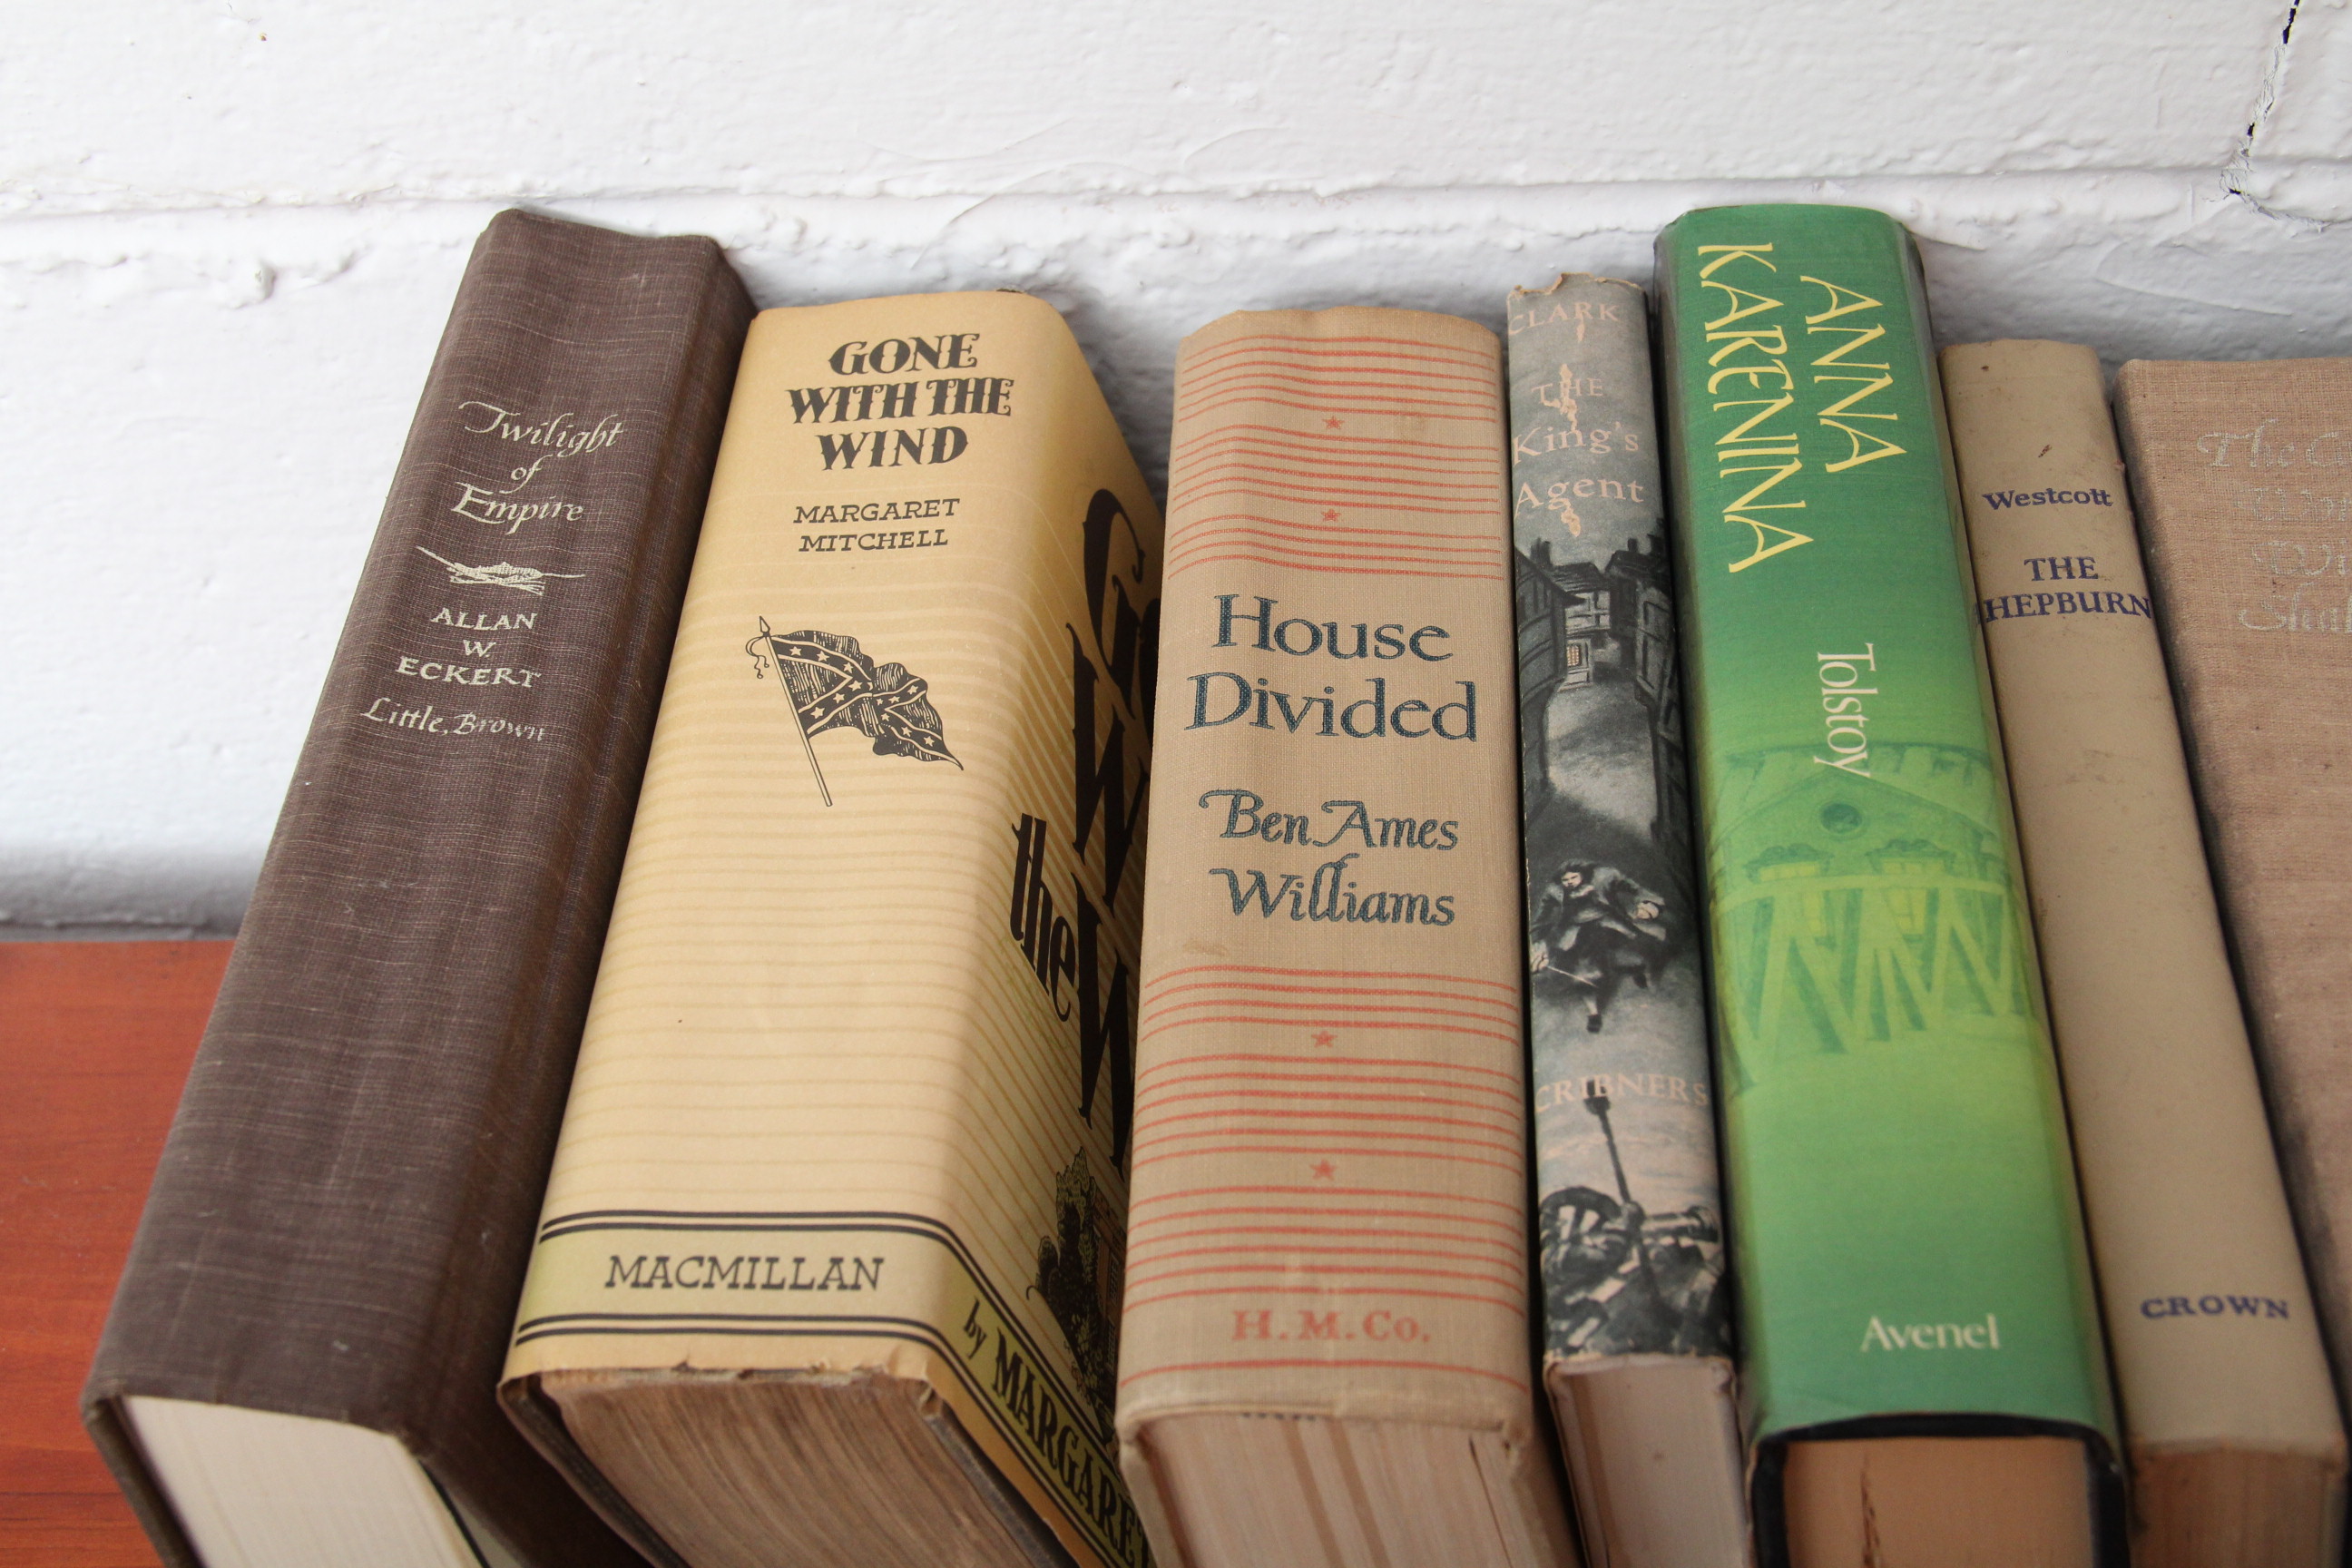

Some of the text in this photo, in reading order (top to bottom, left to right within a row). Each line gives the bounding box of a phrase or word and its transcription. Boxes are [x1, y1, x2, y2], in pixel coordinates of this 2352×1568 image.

[1508, 300, 1619, 336] CLARK
[828, 333, 981, 376] GONE
[1799, 275, 1907, 473] ANNA
[785, 377, 1015, 425] WITH THE
[1531, 377, 1605, 407] THE
[1697, 242, 1814, 573] KARENINA
[458, 400, 624, 459] Twilight
[814, 425, 969, 471] WIND
[1512, 421, 1640, 466] King's
[2196, 417, 2296, 468] The
[499, 454, 553, 495] of
[450, 481, 584, 535] Empire
[793, 497, 961, 524] MARGARET
[1514, 477, 1645, 522] Agent
[1982, 486, 2114, 511] Westcott
[799, 529, 949, 553] MITCHELL
[2023, 555, 2100, 582] THE
[430, 606, 539, 631] ALLAN
[1211, 593, 1454, 662] House
[1984, 590, 2151, 622] HEPBURN
[395, 656, 543, 688] ECKERT
[359, 697, 545, 742] Little, Brown
[1184, 671, 1478, 743] Divided
[1814, 642, 1878, 779] Tolstoy
[1198, 789, 1459, 851] Ben Ames
[1209, 853, 1456, 927] Williams
[1010, 813, 1075, 1023] the
[1534, 1073, 1710, 1113] CRIBNERS
[604, 1256, 885, 1293] MACMILLAN
[963, 1298, 987, 1360] by
[2141, 1294, 2290, 1321] CROWN
[1859, 1312, 2001, 1353] Avenel
